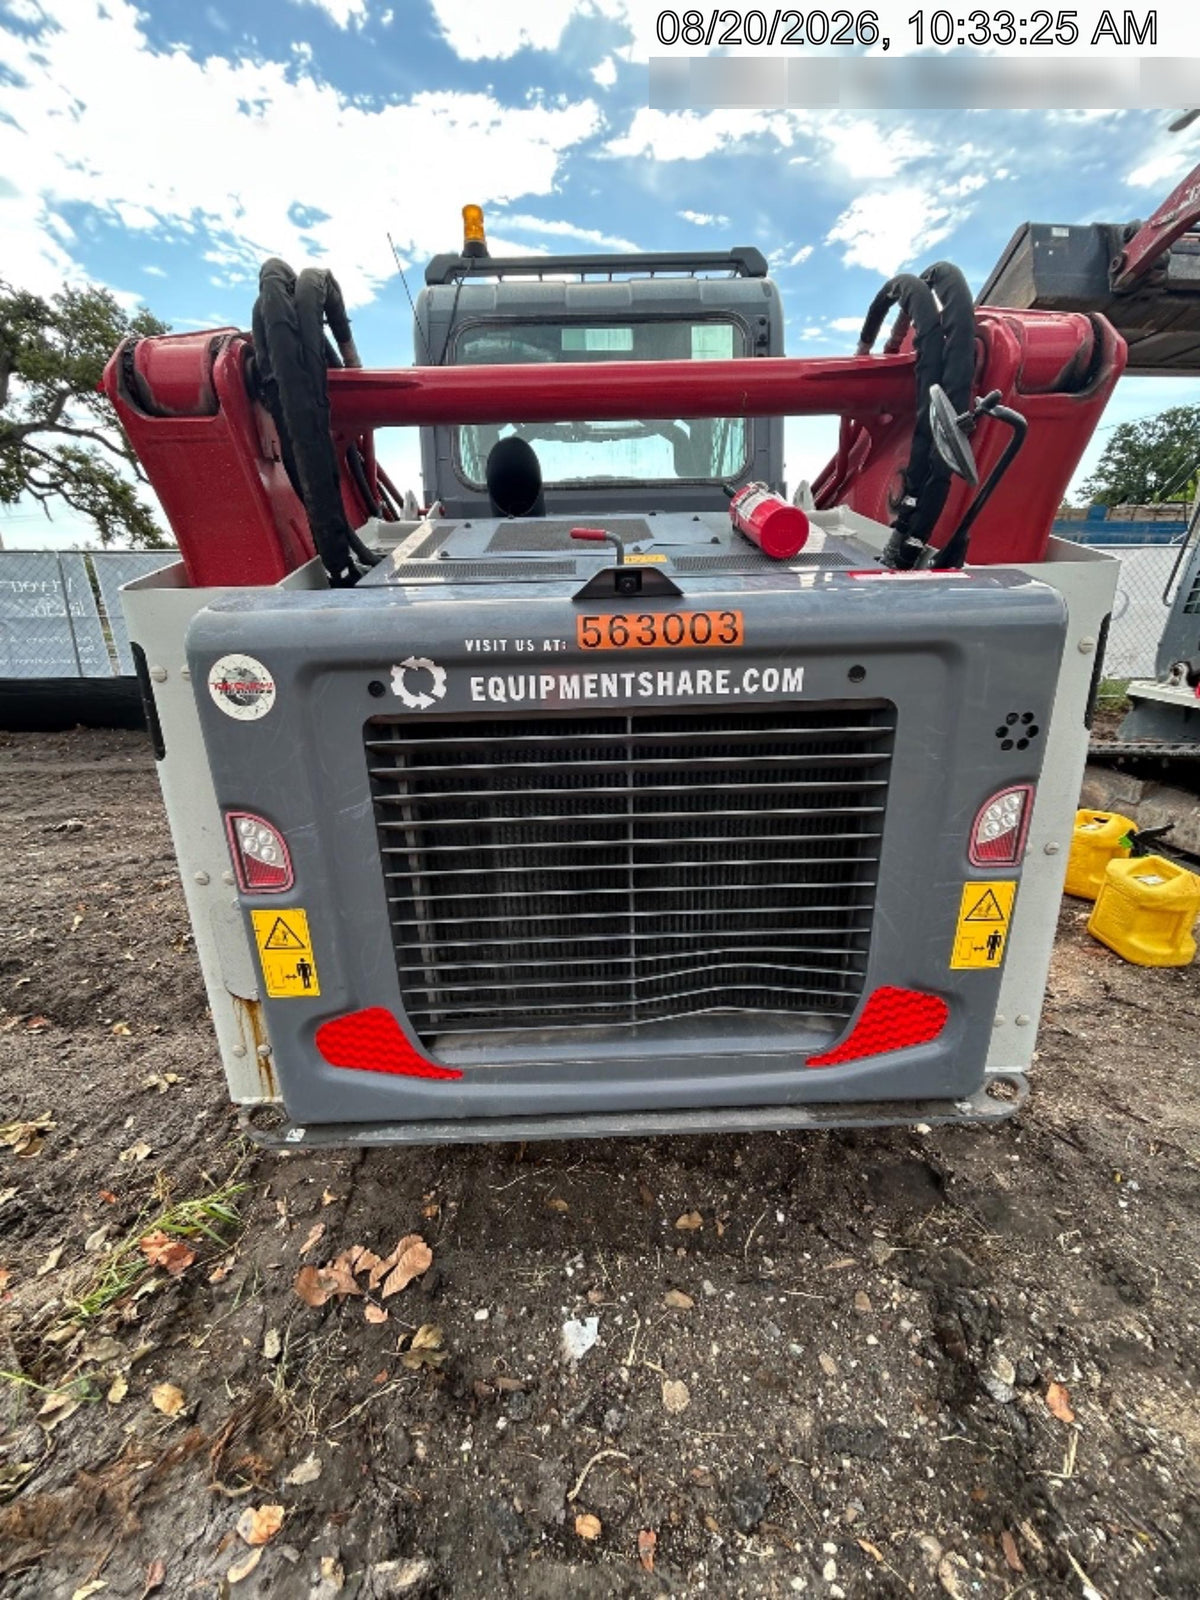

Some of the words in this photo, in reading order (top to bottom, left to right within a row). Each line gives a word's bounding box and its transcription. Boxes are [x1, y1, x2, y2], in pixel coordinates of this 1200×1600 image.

[464, 639, 508, 652] VISIT
[515, 639, 536, 652] US
[543, 639, 567, 652] AT:
[581, 611, 741, 648] 563003
[470, 667, 805, 703] EQUIPMENTSHARE.COM
